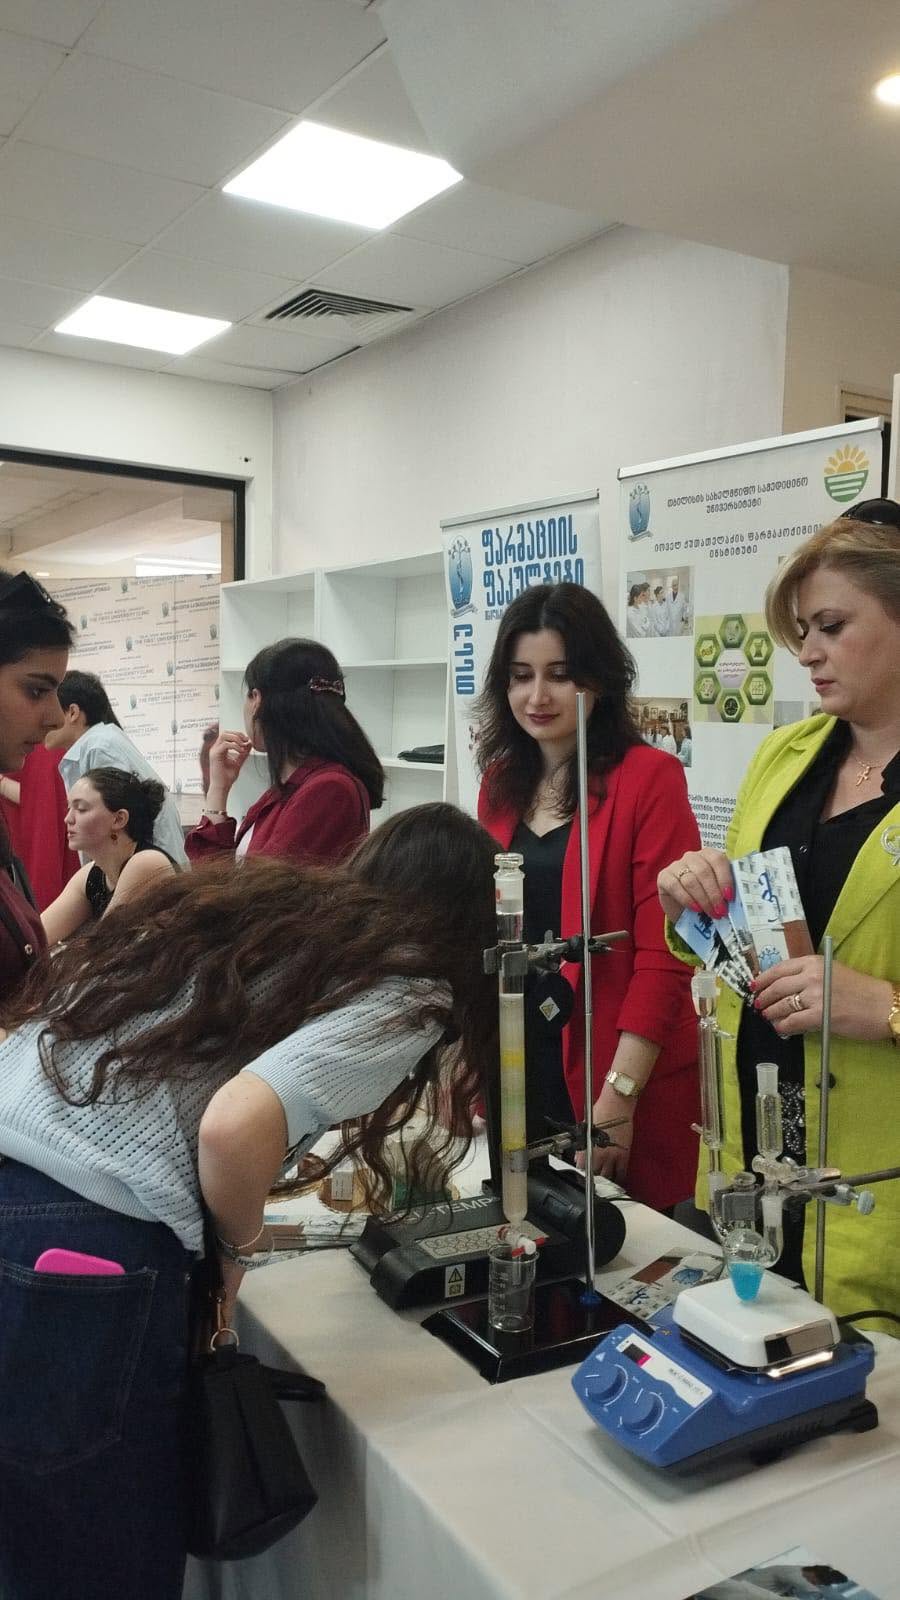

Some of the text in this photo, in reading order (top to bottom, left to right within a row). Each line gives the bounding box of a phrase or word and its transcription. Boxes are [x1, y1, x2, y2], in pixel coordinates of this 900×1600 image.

[667, 476, 809, 508] თბილისის სახელმწიფო სამედიცინო
[706, 497, 762, 514] უნივერსიტეტი
[481, 514, 578, 567] ფარმაციის
[747, 523, 823, 541] ფარმაკოქიმიი
[709, 544, 758, 559] ინსტიტუტი
